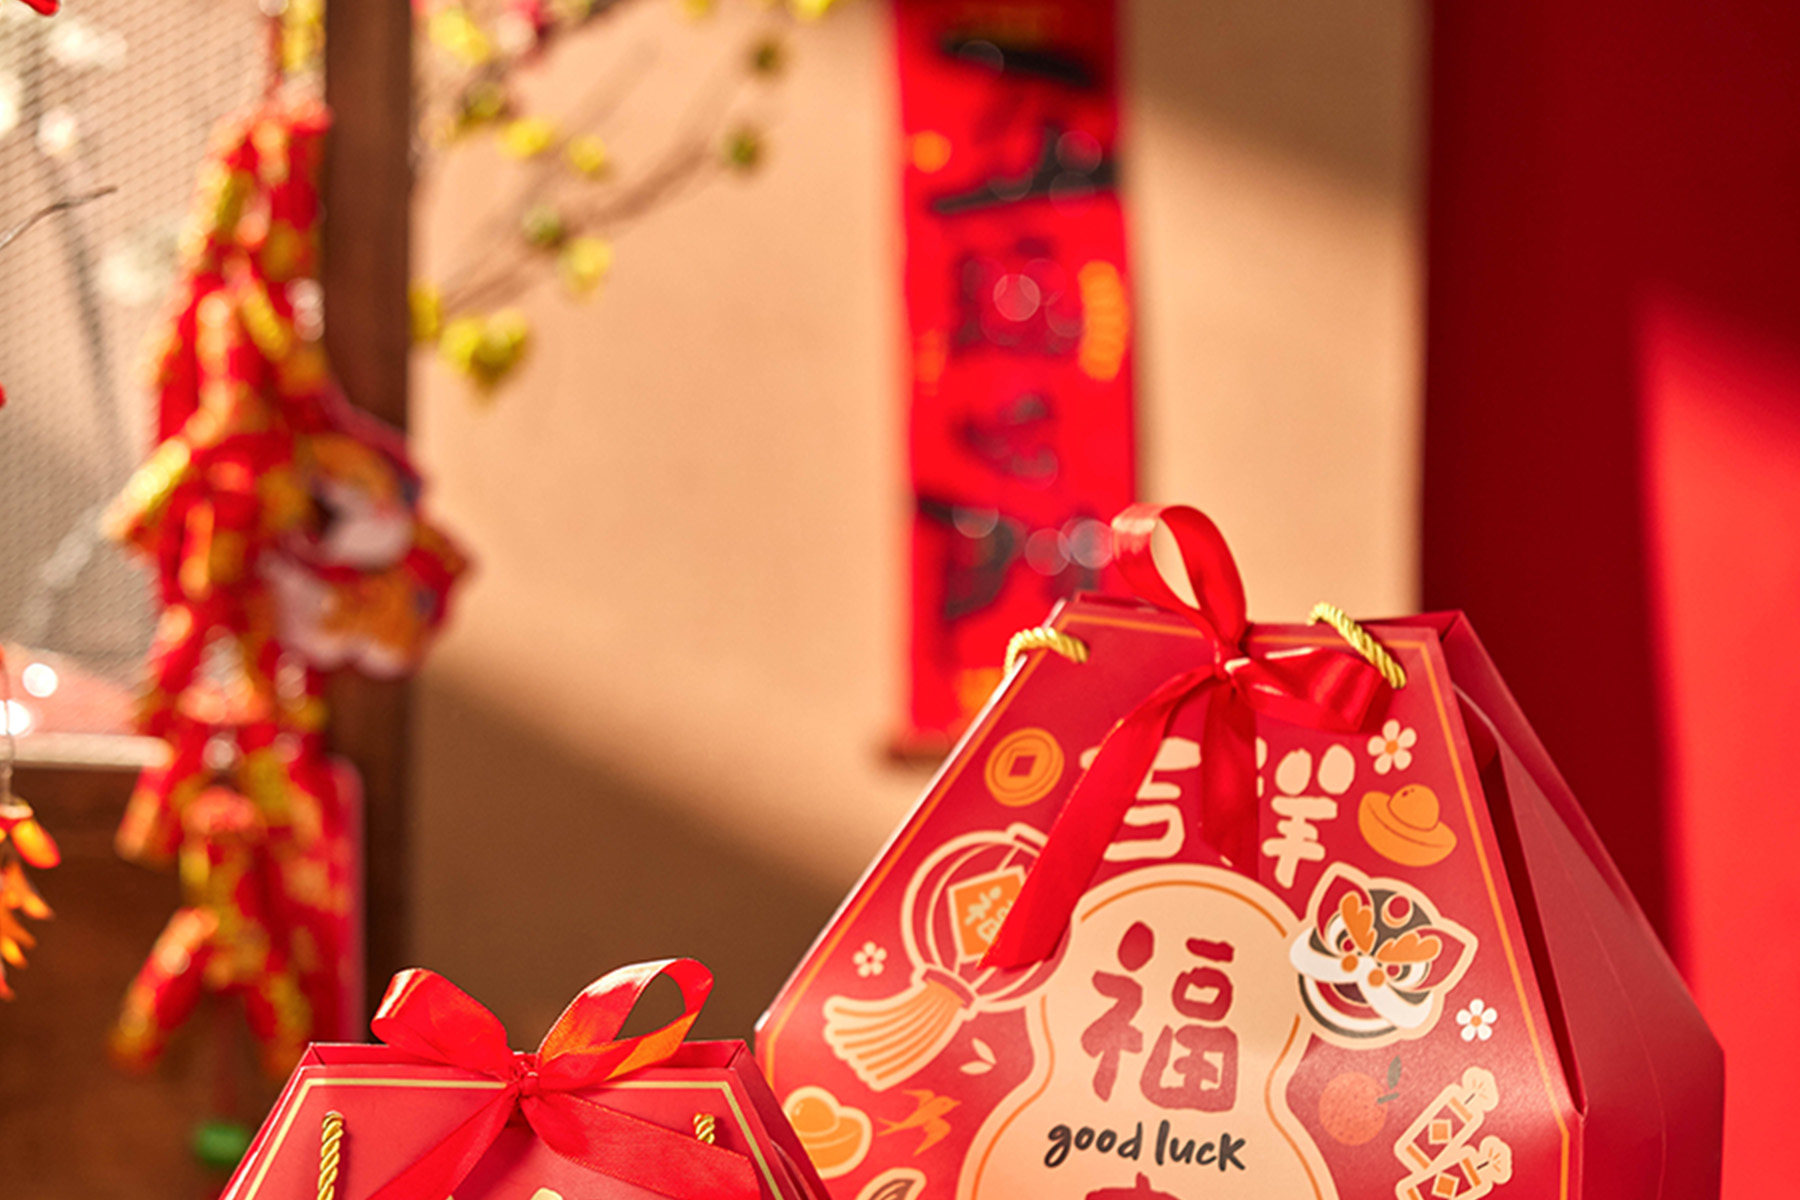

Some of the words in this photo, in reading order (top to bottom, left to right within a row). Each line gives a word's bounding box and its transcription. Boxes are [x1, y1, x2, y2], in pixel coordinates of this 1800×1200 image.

[1080, 920, 1239, 1113] 福
[1044, 1121, 1143, 1168] good
[1155, 1119, 1246, 1172] luck
